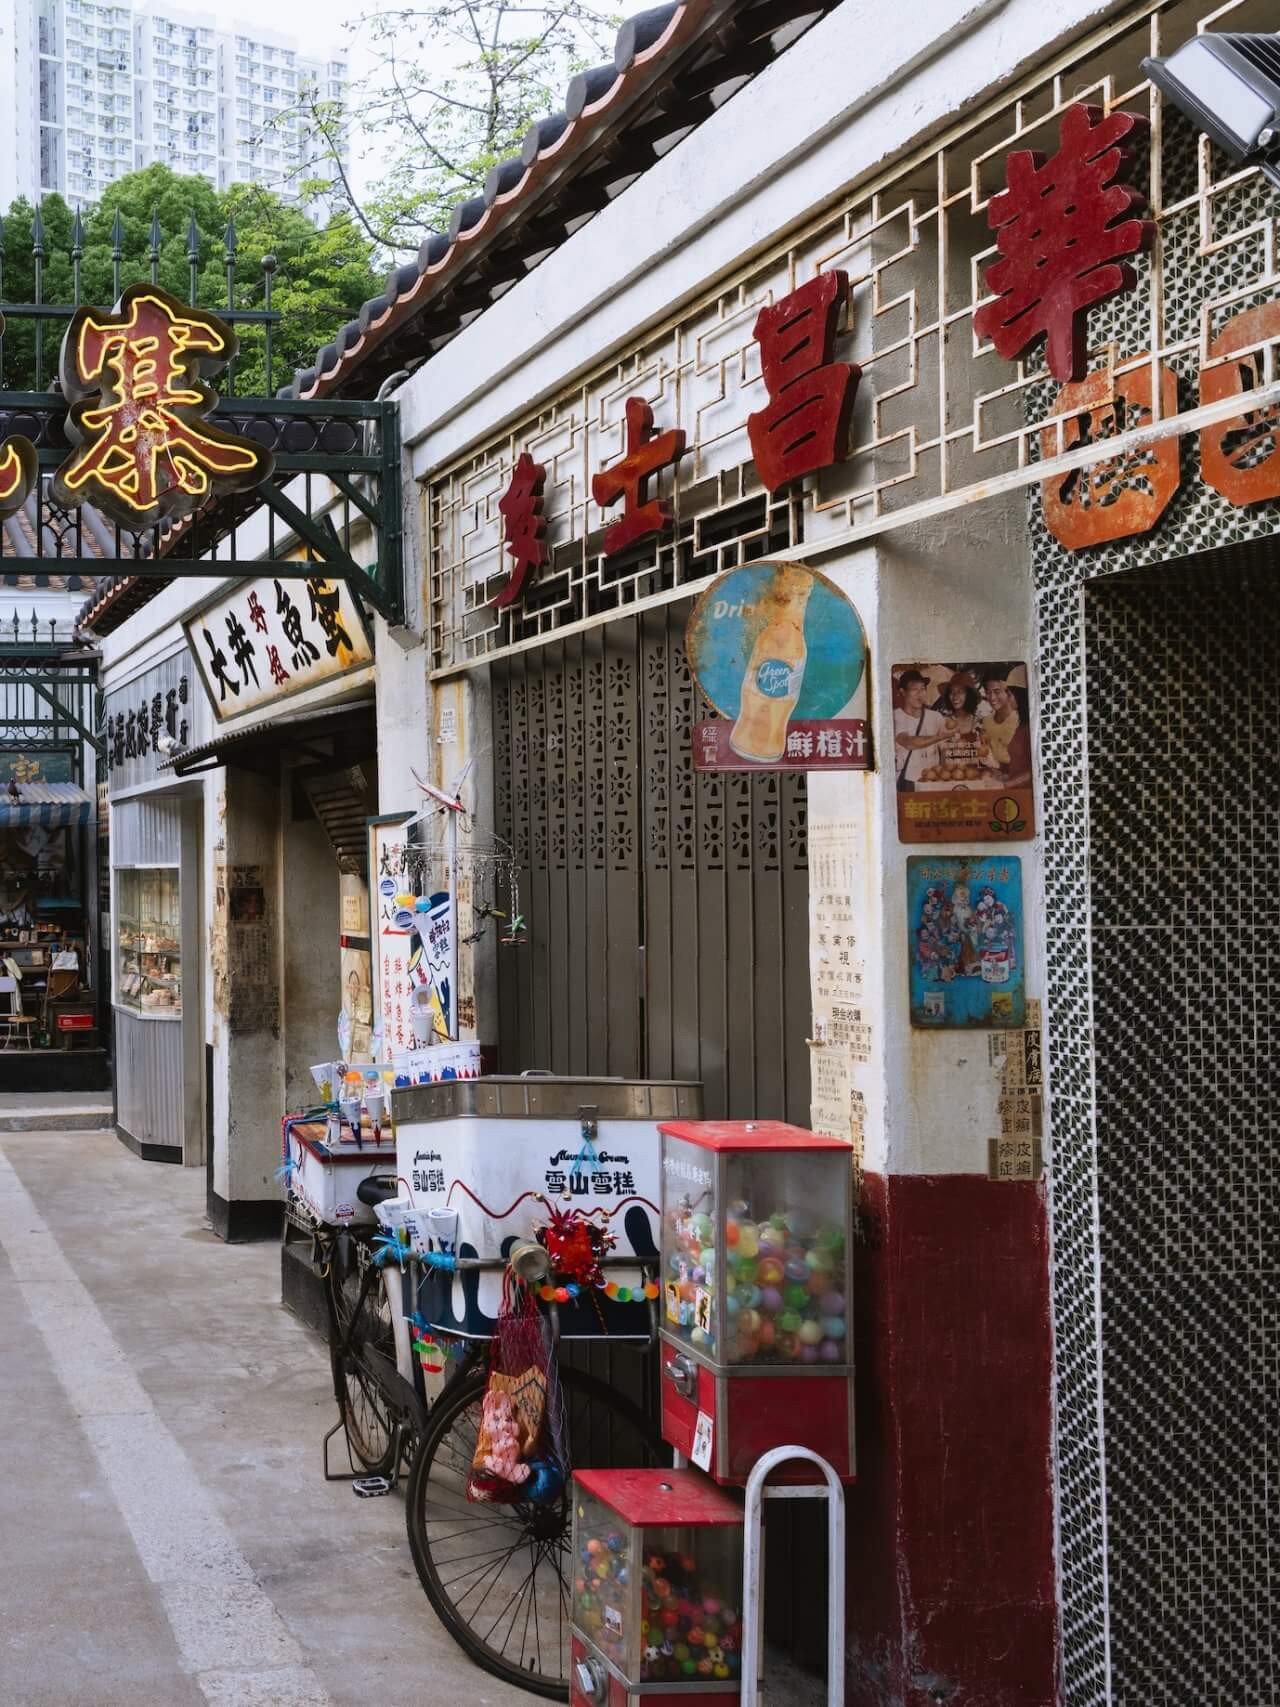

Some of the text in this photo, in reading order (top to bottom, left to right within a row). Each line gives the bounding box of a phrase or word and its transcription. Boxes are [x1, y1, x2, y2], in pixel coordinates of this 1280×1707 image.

[758, 661, 791, 681] Green
[787, 730, 868, 758] 鮮橙汁
[545, 1170, 638, 1196] 雪山雪糕
